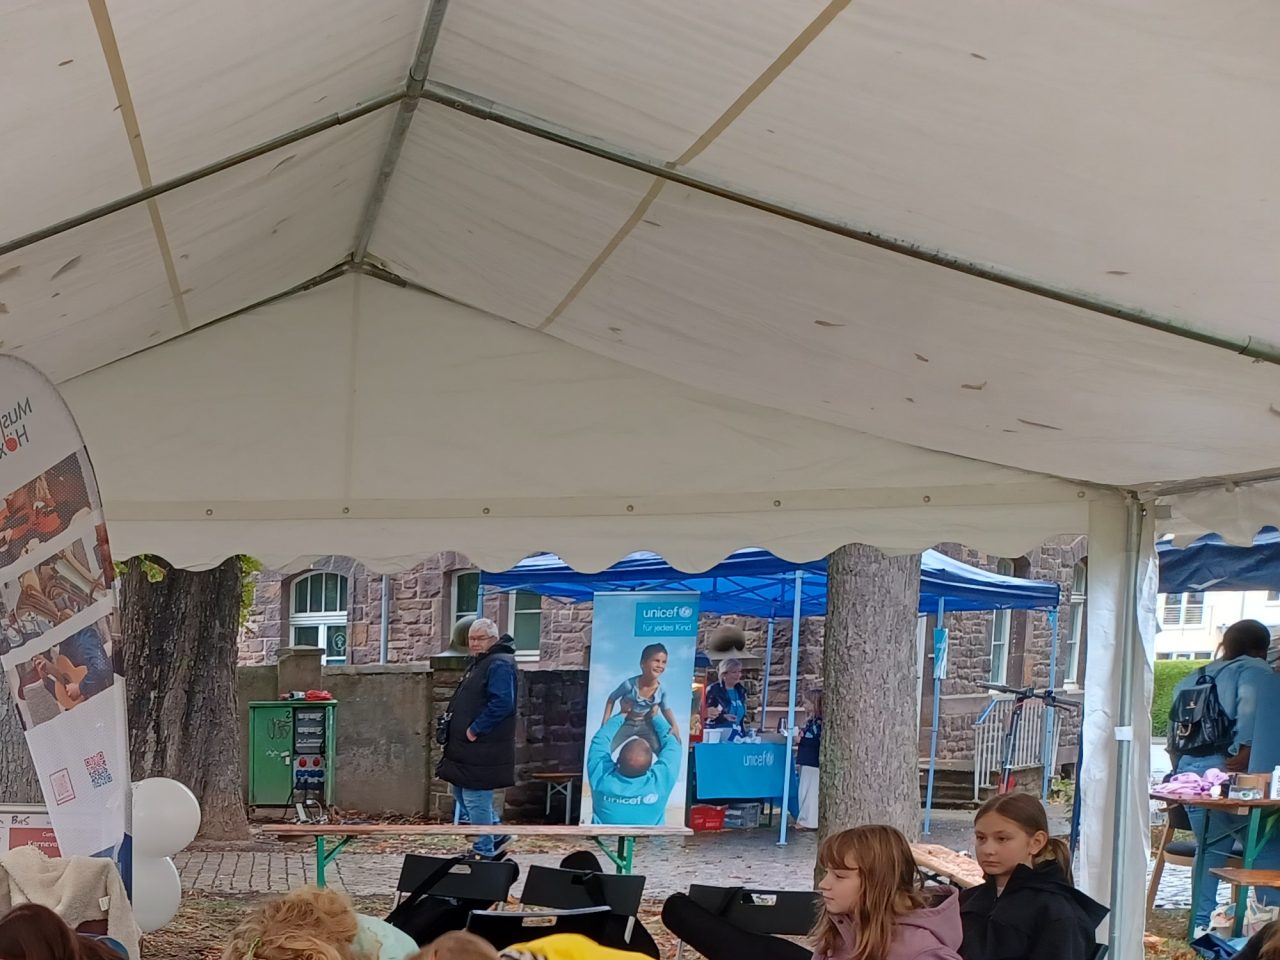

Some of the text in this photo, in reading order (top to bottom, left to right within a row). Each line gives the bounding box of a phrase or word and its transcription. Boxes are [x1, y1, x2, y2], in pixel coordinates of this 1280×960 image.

[643, 606, 679, 618] unicef
[654, 624, 674, 632] jedes
[675, 623, 692, 631] Kind
[743, 751, 767, 767] unicef
[603, 795, 642, 805] unicef
